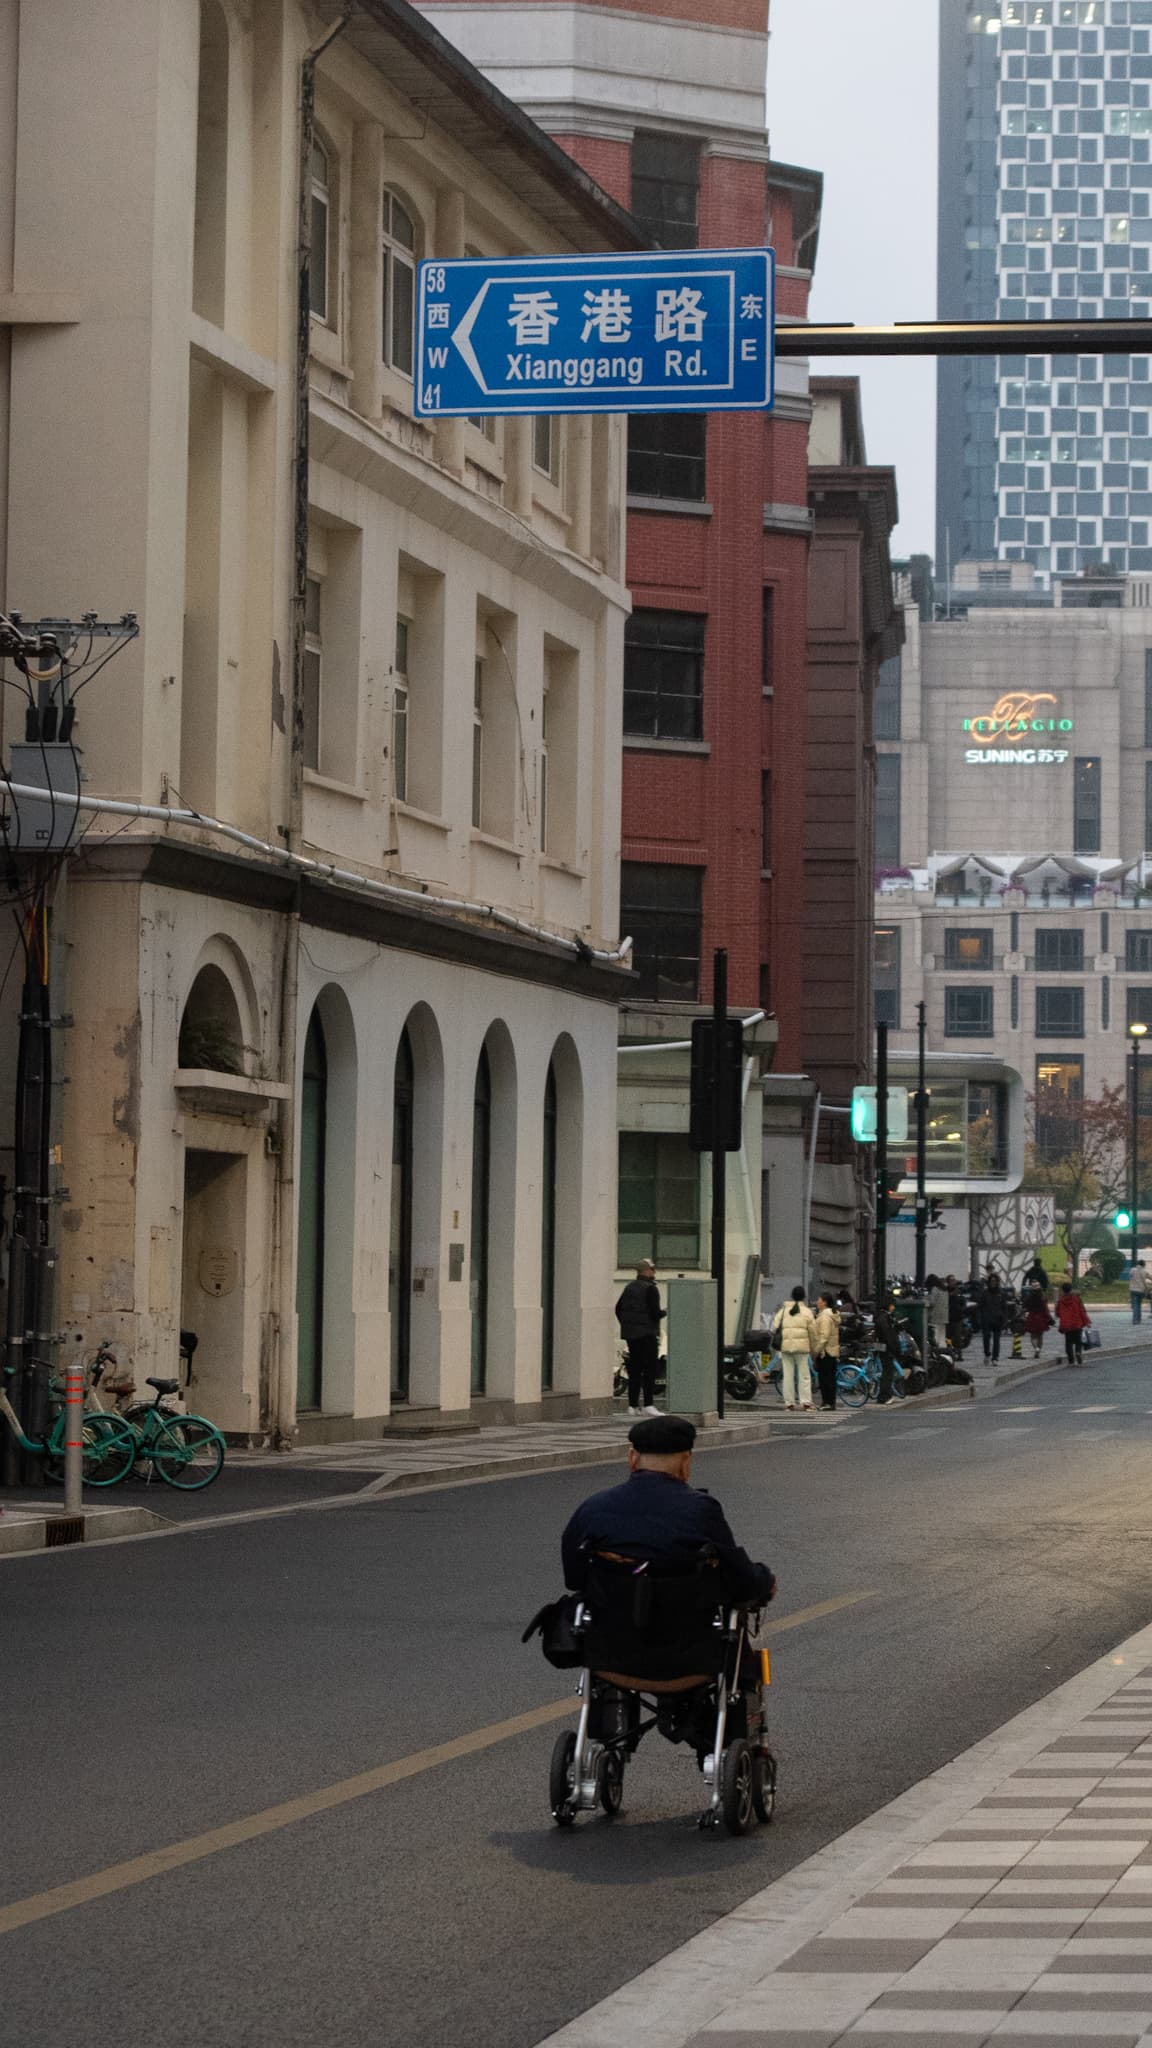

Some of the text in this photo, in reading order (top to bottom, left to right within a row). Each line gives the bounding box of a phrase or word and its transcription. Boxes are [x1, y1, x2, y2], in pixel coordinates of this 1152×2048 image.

[427, 268, 446, 294] 58
[427, 303, 450, 330] 西
[507, 287, 708, 346] 香港路
[740, 294, 763, 320] 东
[428, 347, 449, 369] W
[741, 339, 757, 361] E
[506, 350, 708, 386] Xianggang Rd.
[424, 384, 441, 409] 41
[963, 719, 1073, 731] BELLAGIO
[965, 749, 1069, 763] SUNING 苏宁
